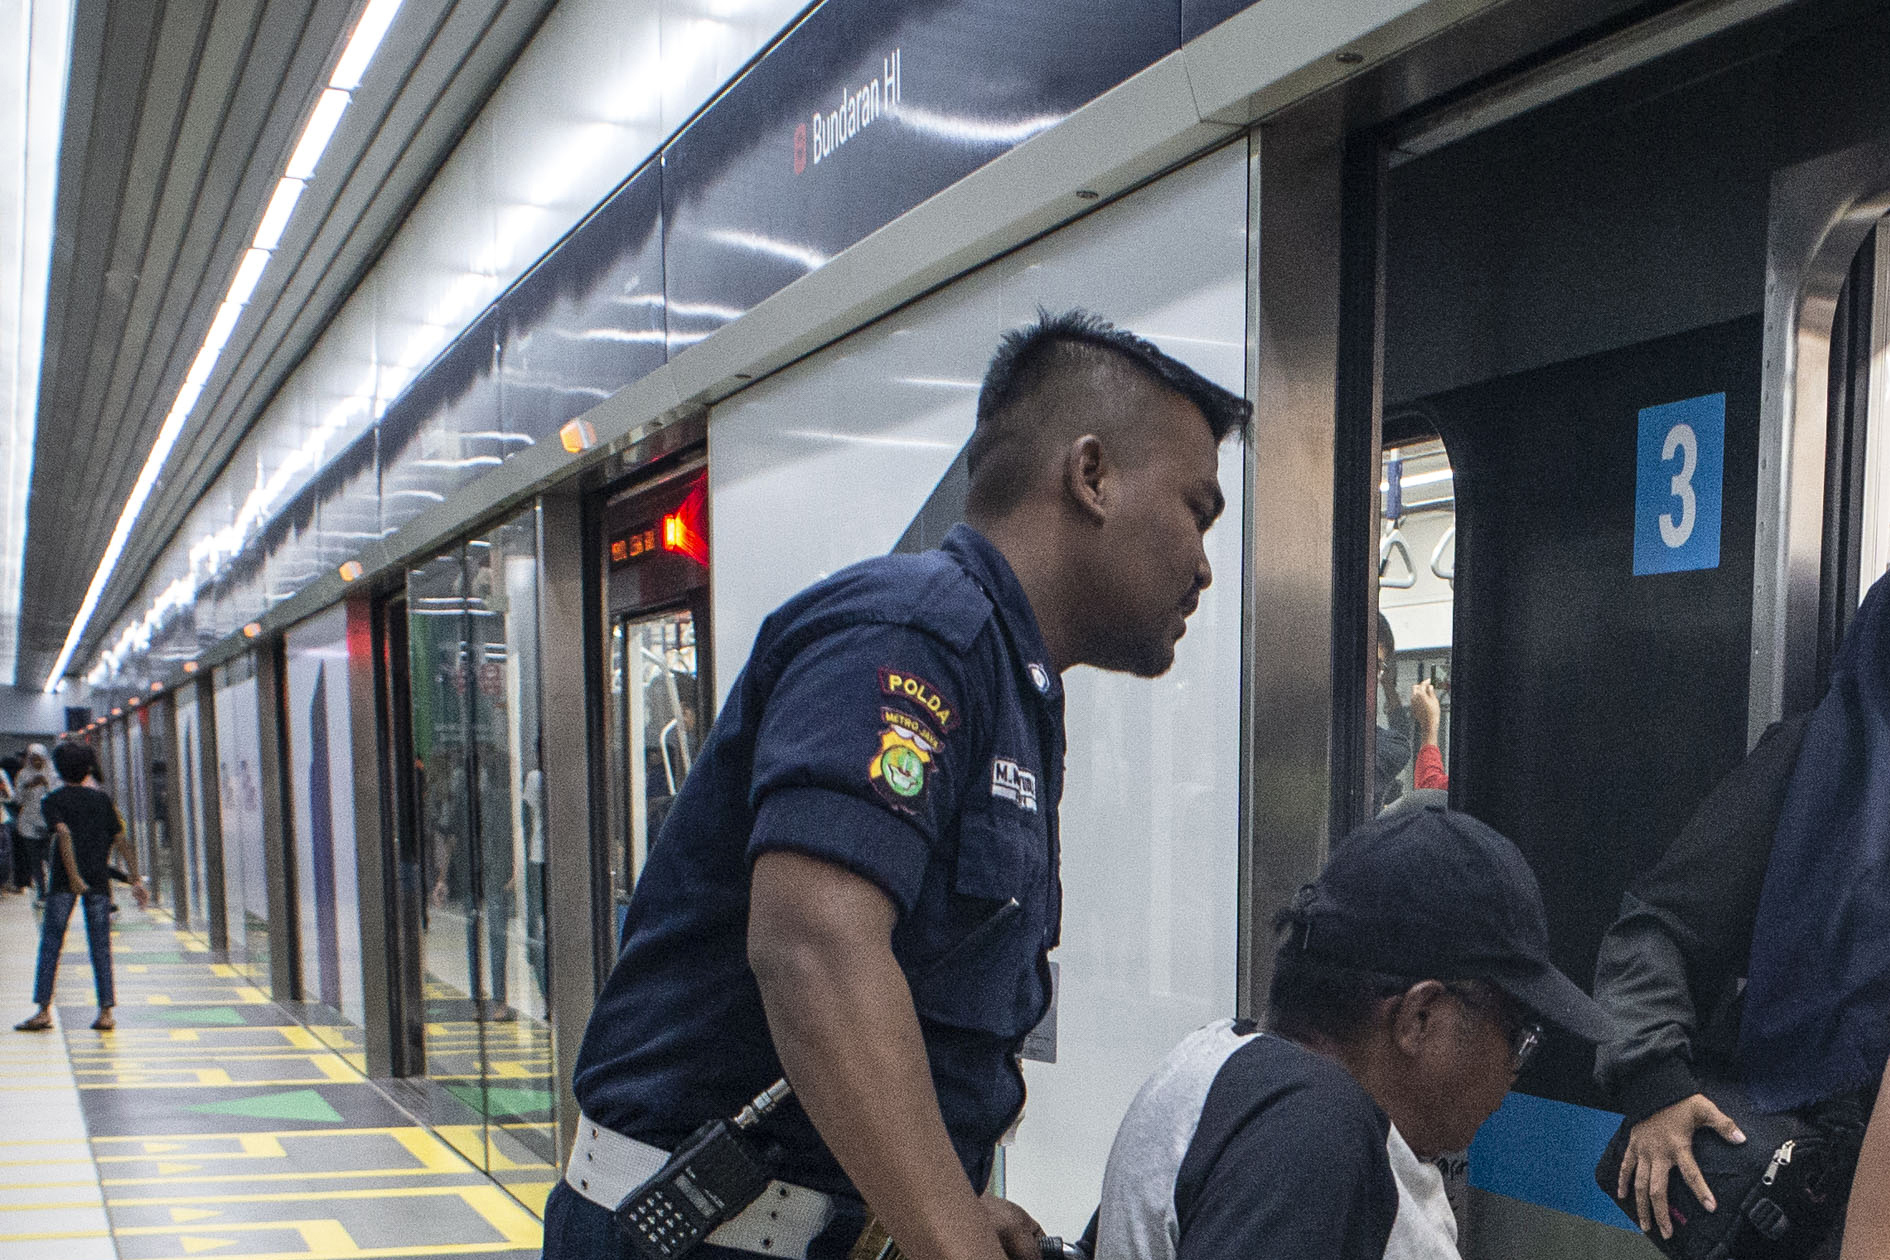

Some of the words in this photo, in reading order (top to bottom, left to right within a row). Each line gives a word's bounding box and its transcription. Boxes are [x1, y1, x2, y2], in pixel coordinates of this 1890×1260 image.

[812, 78, 880, 165] Bundaran
[883, 47, 901, 111] HI
[1658, 423, 1698, 548] 3
[885, 711, 919, 731] METRO
[888, 674, 950, 725] POLDA
